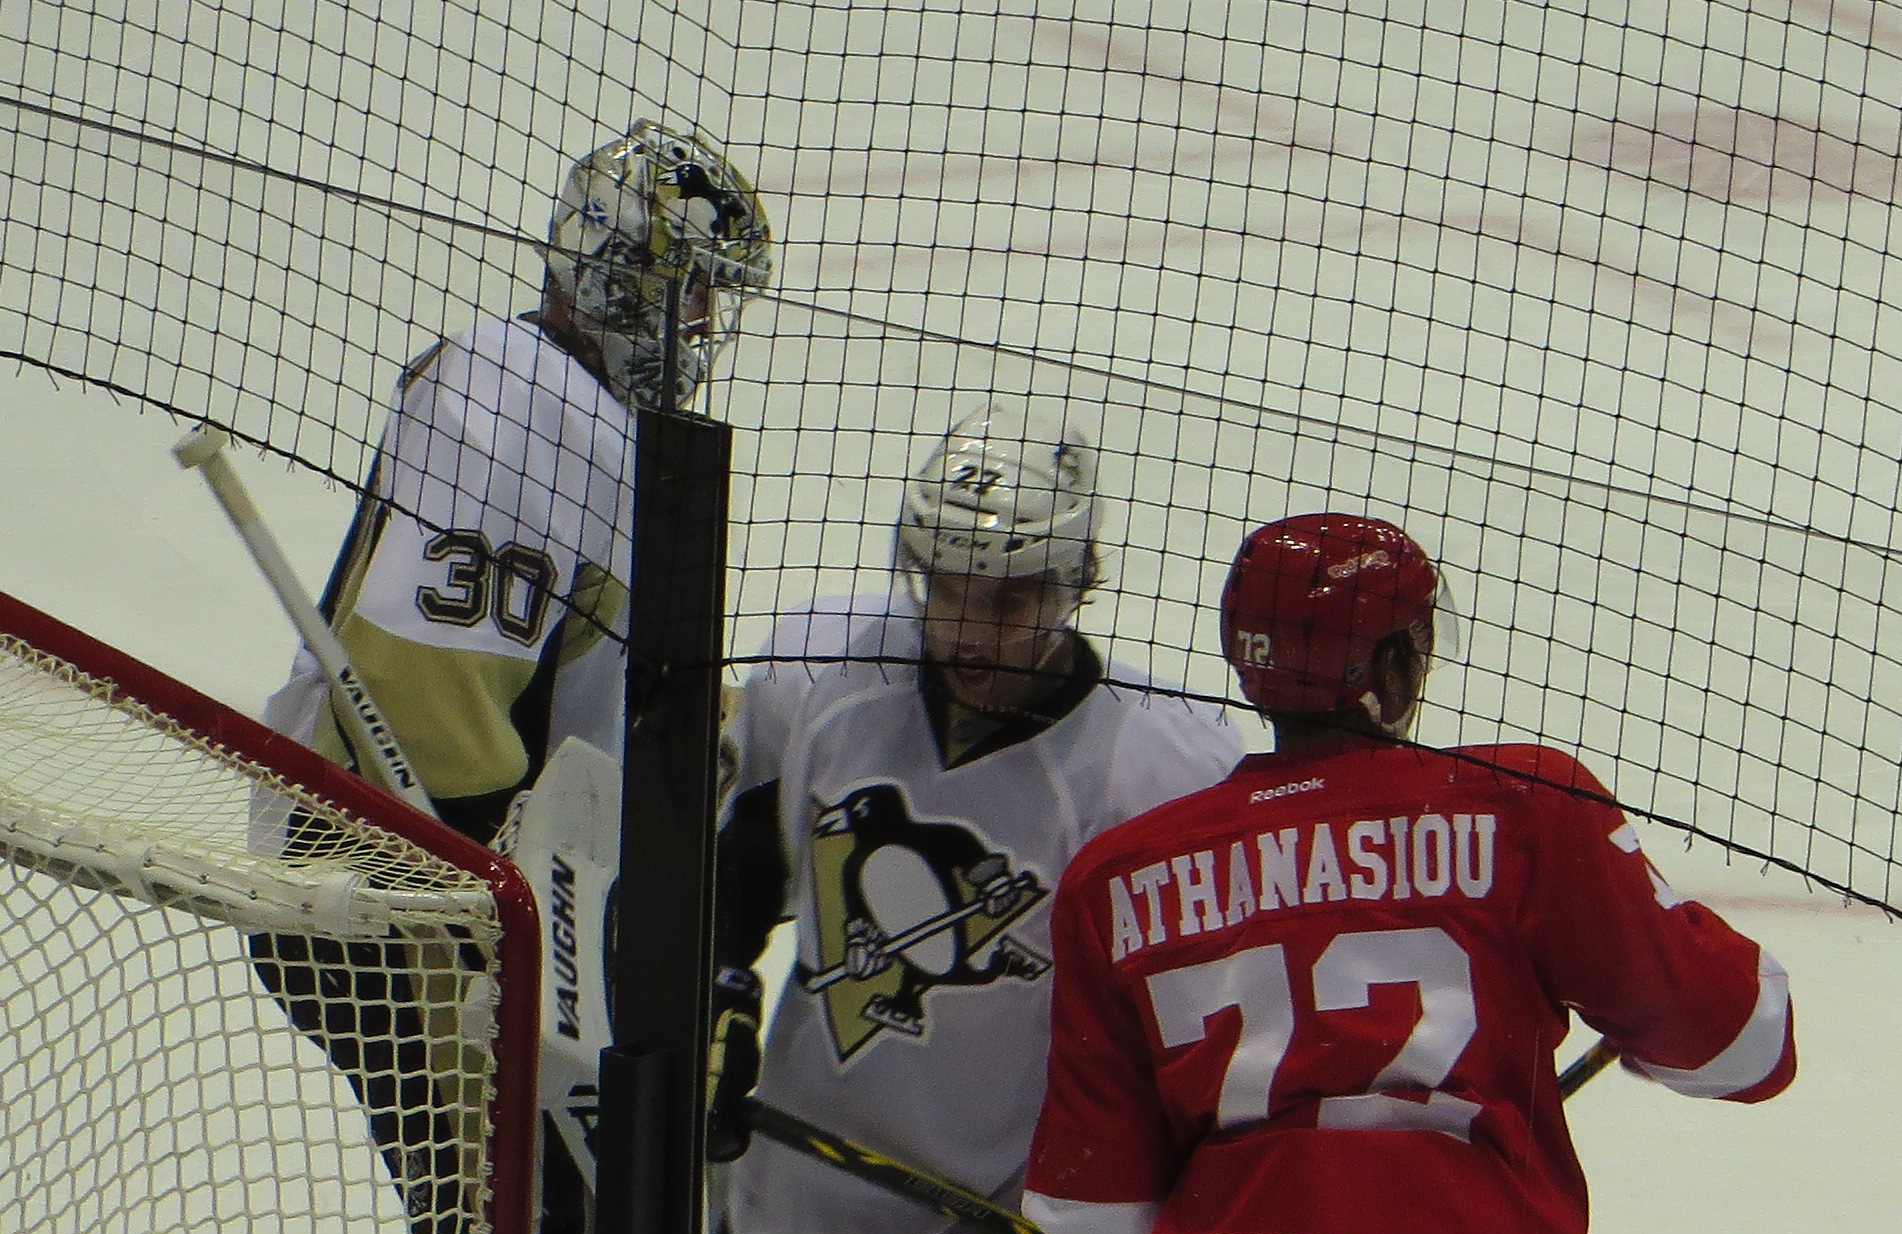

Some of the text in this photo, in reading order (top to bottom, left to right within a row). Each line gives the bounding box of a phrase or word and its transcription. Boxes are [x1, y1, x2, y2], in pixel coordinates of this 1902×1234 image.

[415, 528, 559, 648] 30
[1237, 629, 1274, 669] 72
[339, 665, 416, 788] VAUGHN
[1249, 777, 1325, 804] Reebok
[551, 853, 581, 1041] VAUGHN
[1108, 813, 1497, 963] ATHANASIOU
[1144, 926, 1485, 1144] 72
